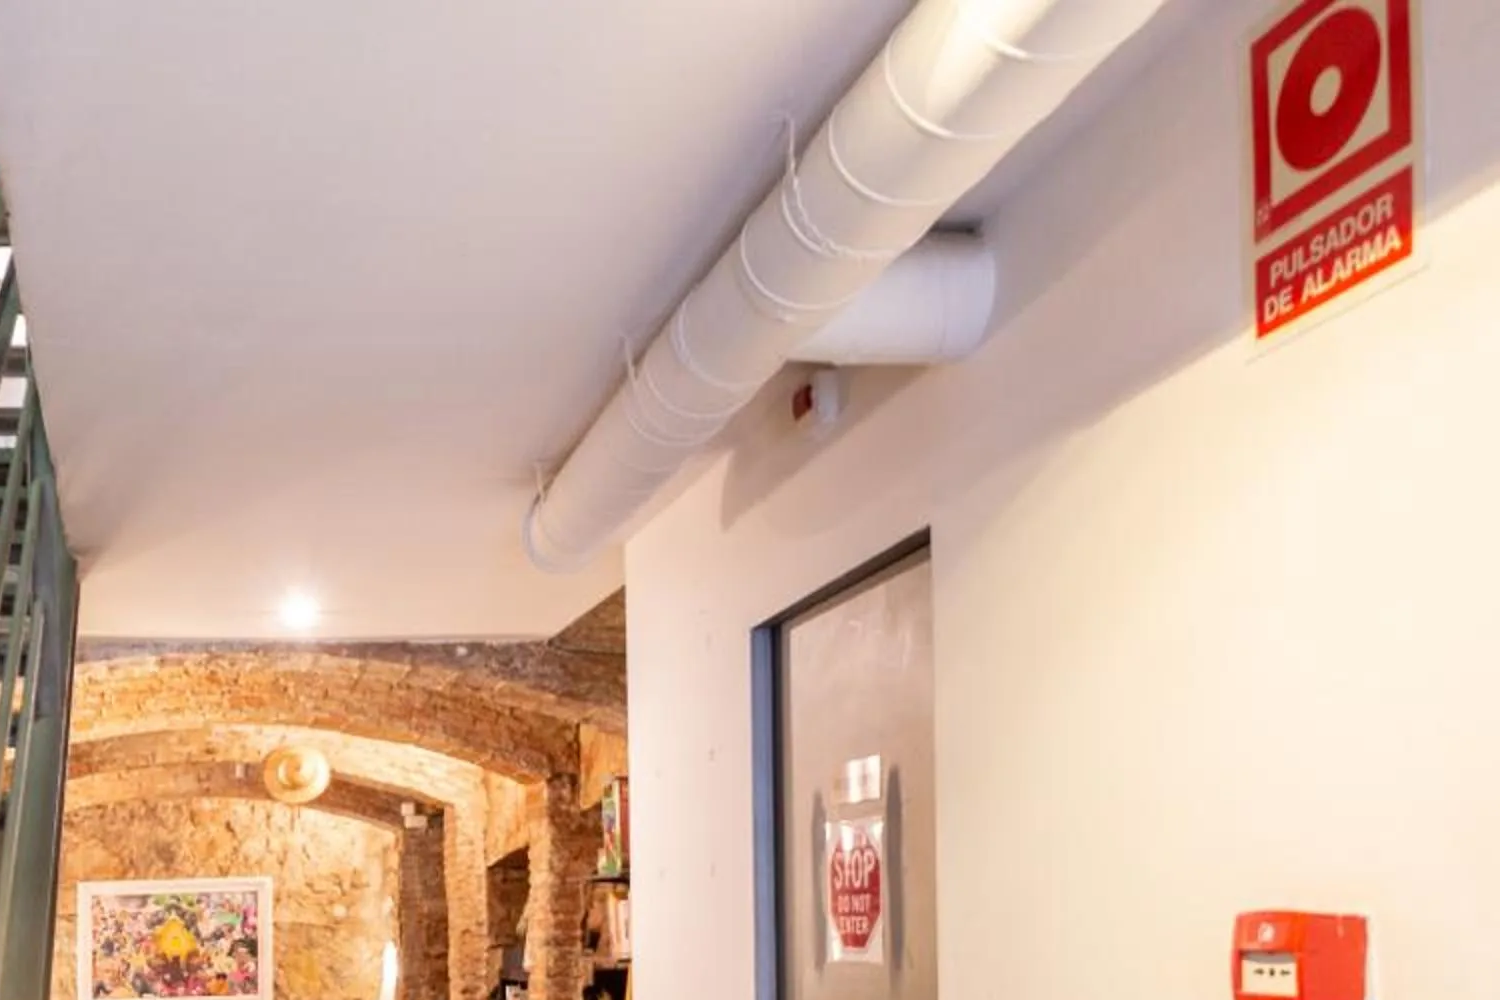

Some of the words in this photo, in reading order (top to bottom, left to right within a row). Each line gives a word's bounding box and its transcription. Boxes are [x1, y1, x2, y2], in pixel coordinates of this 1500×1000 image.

[1264, 286, 1295, 324] DE
[1302, 224, 1402, 304] ALARMA
[1270, 193, 1394, 288] PULSADOR
[833, 848, 876, 889] STOP
